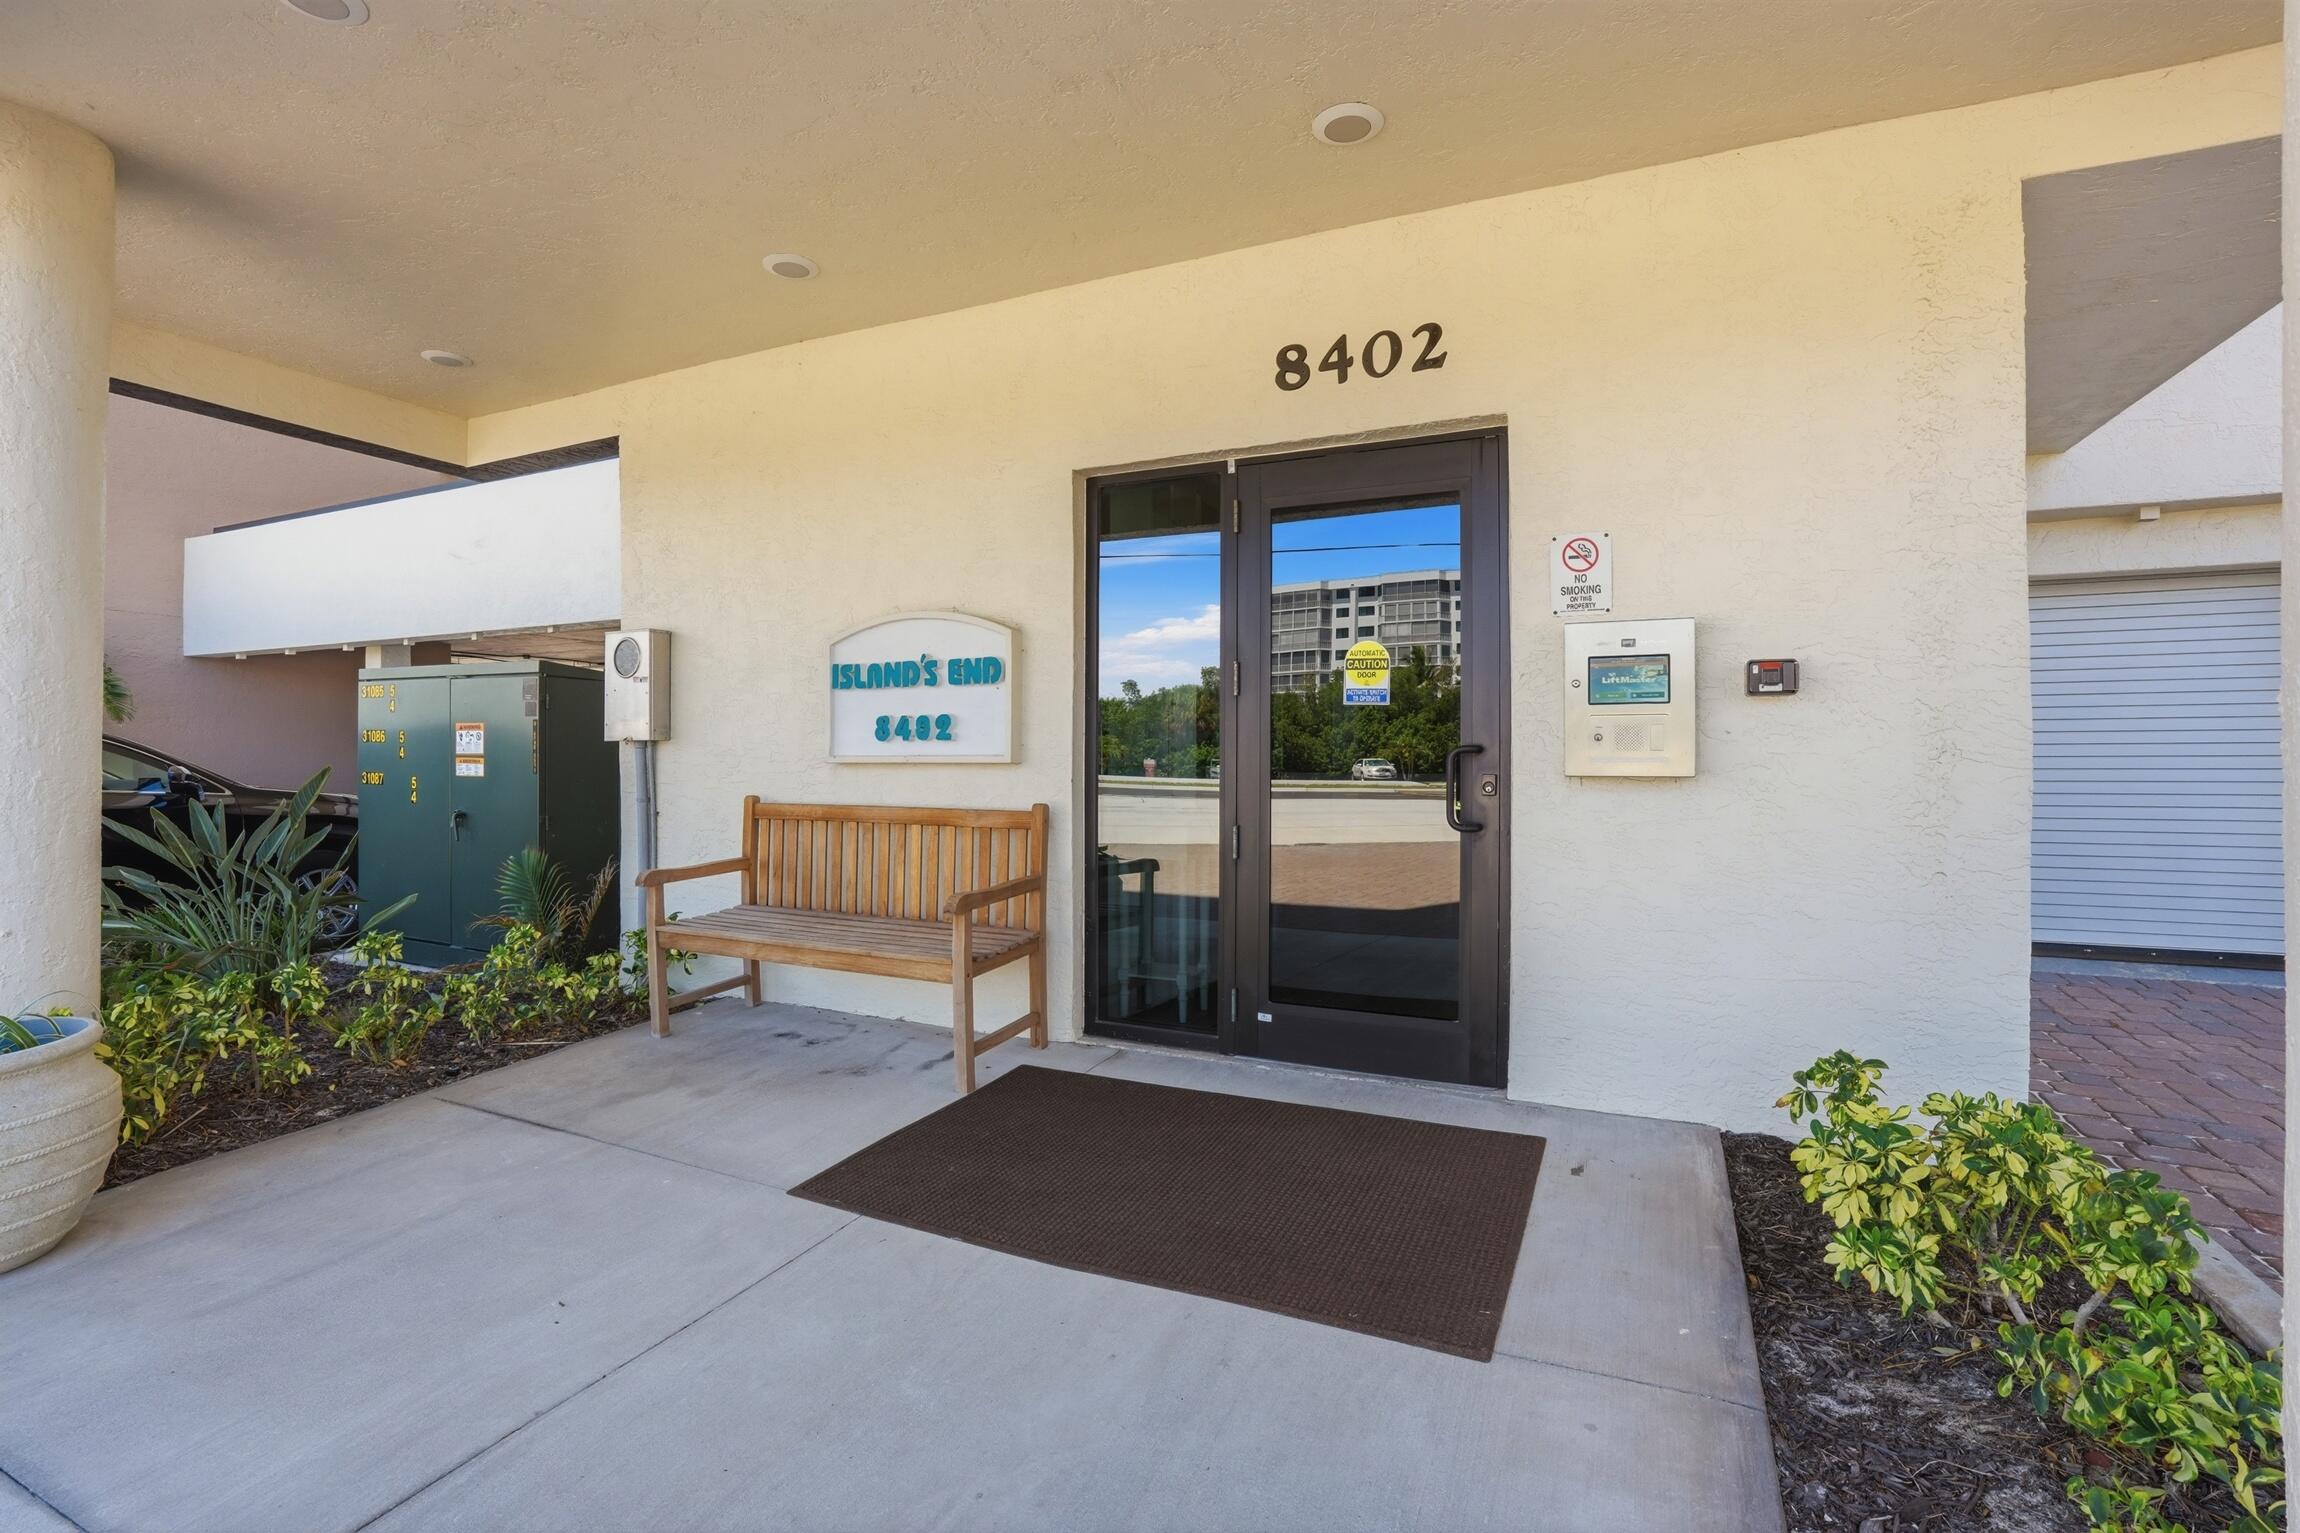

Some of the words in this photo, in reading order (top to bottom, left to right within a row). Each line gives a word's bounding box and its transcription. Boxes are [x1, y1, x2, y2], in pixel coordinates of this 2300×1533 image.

[1275, 322, 1448, 391] 8402
[1574, 573, 1588, 584] NO
[1560, 584, 1602, 596] SMOKING
[1566, 602, 1596, 610] PROPERTY
[1347, 660, 1388, 668] CAUTION
[832, 653, 938, 690] ISLAND'S
[947, 656, 1002, 686] END
[361, 684, 385, 698] 31085
[389, 684, 396, 697] 5
[389, 700, 396, 712] 4
[874, 714, 953, 742] 8402
[362, 730, 386, 742] 31086
[399, 731, 405, 743] 5
[399, 746, 405, 759] 4
[361, 772, 384, 785] 31087
[411, 776, 417, 789] 5
[411, 790, 417, 804] 4
